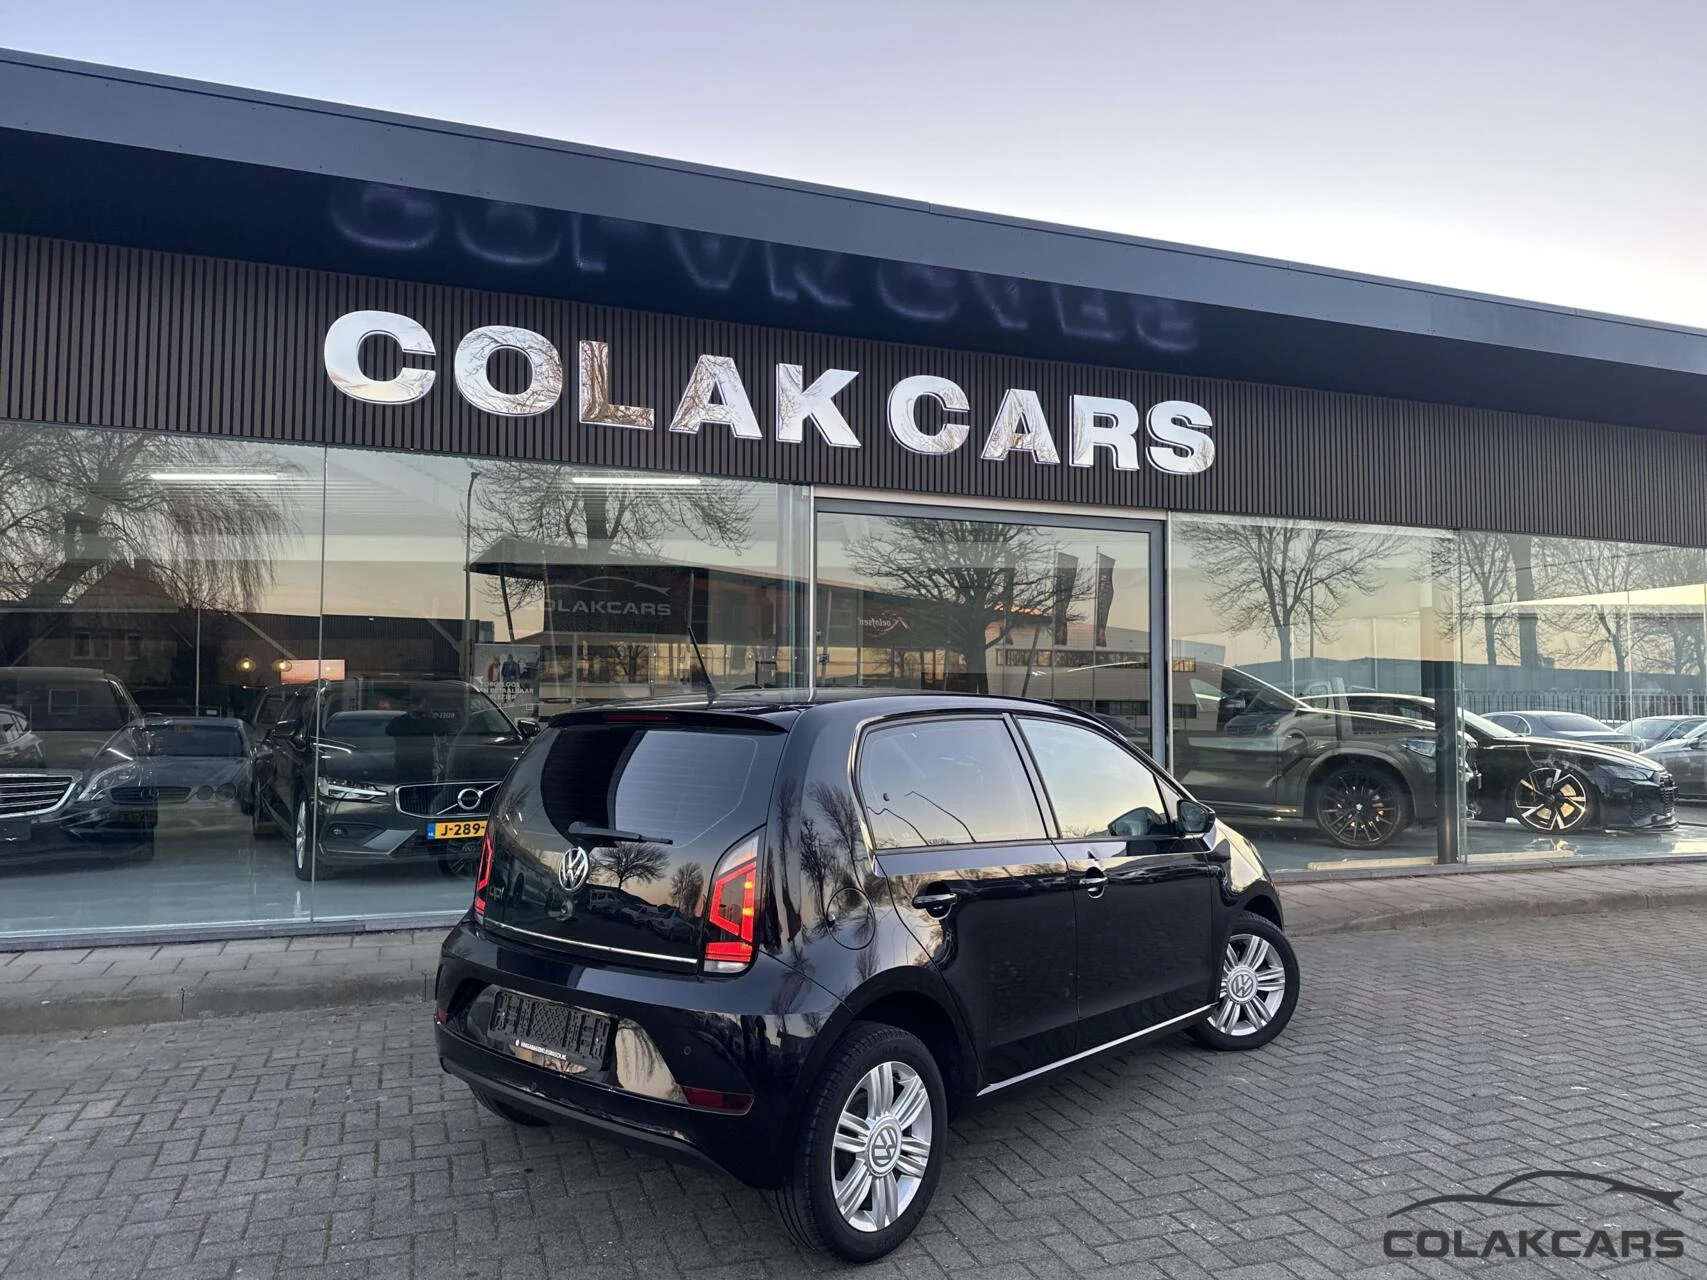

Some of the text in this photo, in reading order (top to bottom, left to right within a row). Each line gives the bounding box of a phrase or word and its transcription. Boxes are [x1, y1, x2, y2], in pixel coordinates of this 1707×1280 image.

[323, 310, 1216, 475] COLAK CARS
[524, 598, 671, 616] OLAKCARS
[440, 822, 486, 837] J-289-
